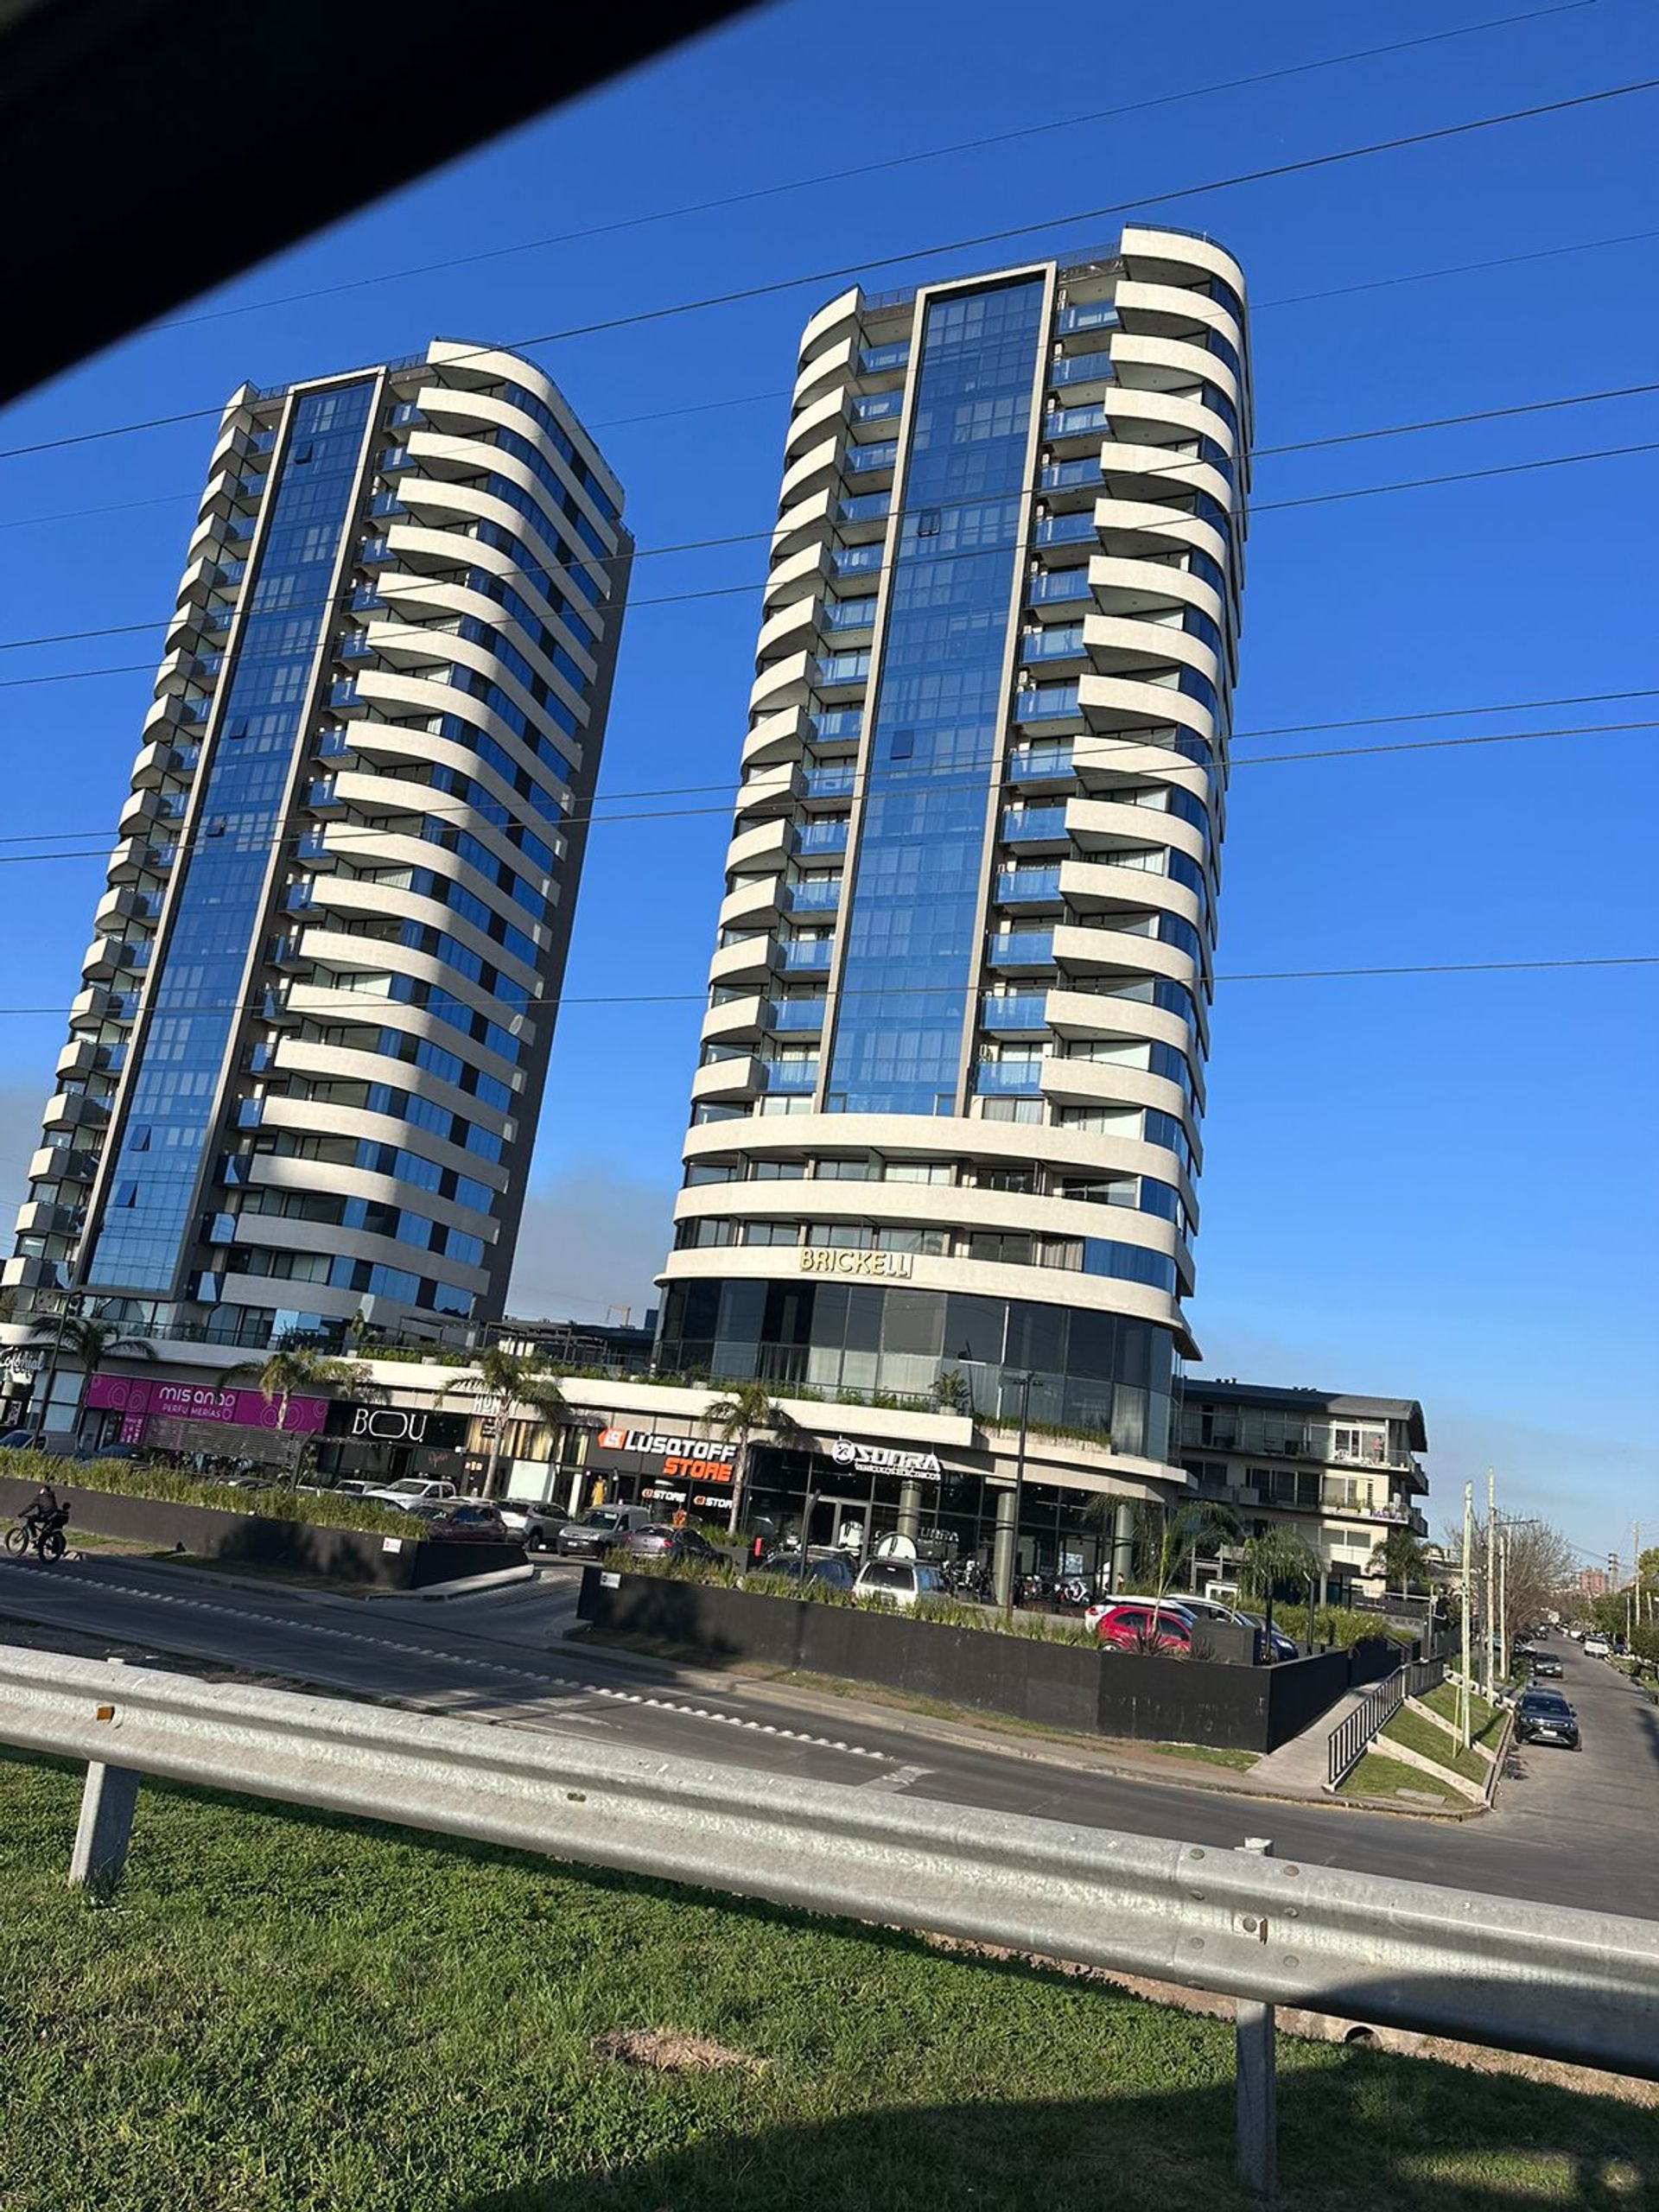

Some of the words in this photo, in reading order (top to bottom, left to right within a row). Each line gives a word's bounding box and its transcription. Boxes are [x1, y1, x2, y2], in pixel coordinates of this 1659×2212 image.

[800, 1248, 913, 1280] BRICKELL
[474, 1394, 519, 1416] HONY
[624, 1430, 737, 1463] LUSQTOFF
[854, 1443, 941, 1473] SUNRA
[662, 1456, 734, 1483] STORE
[653, 1489, 687, 1503] STORE
[705, 1496, 734, 1510] STOR
[920, 1527, 959, 1542] UNRA
